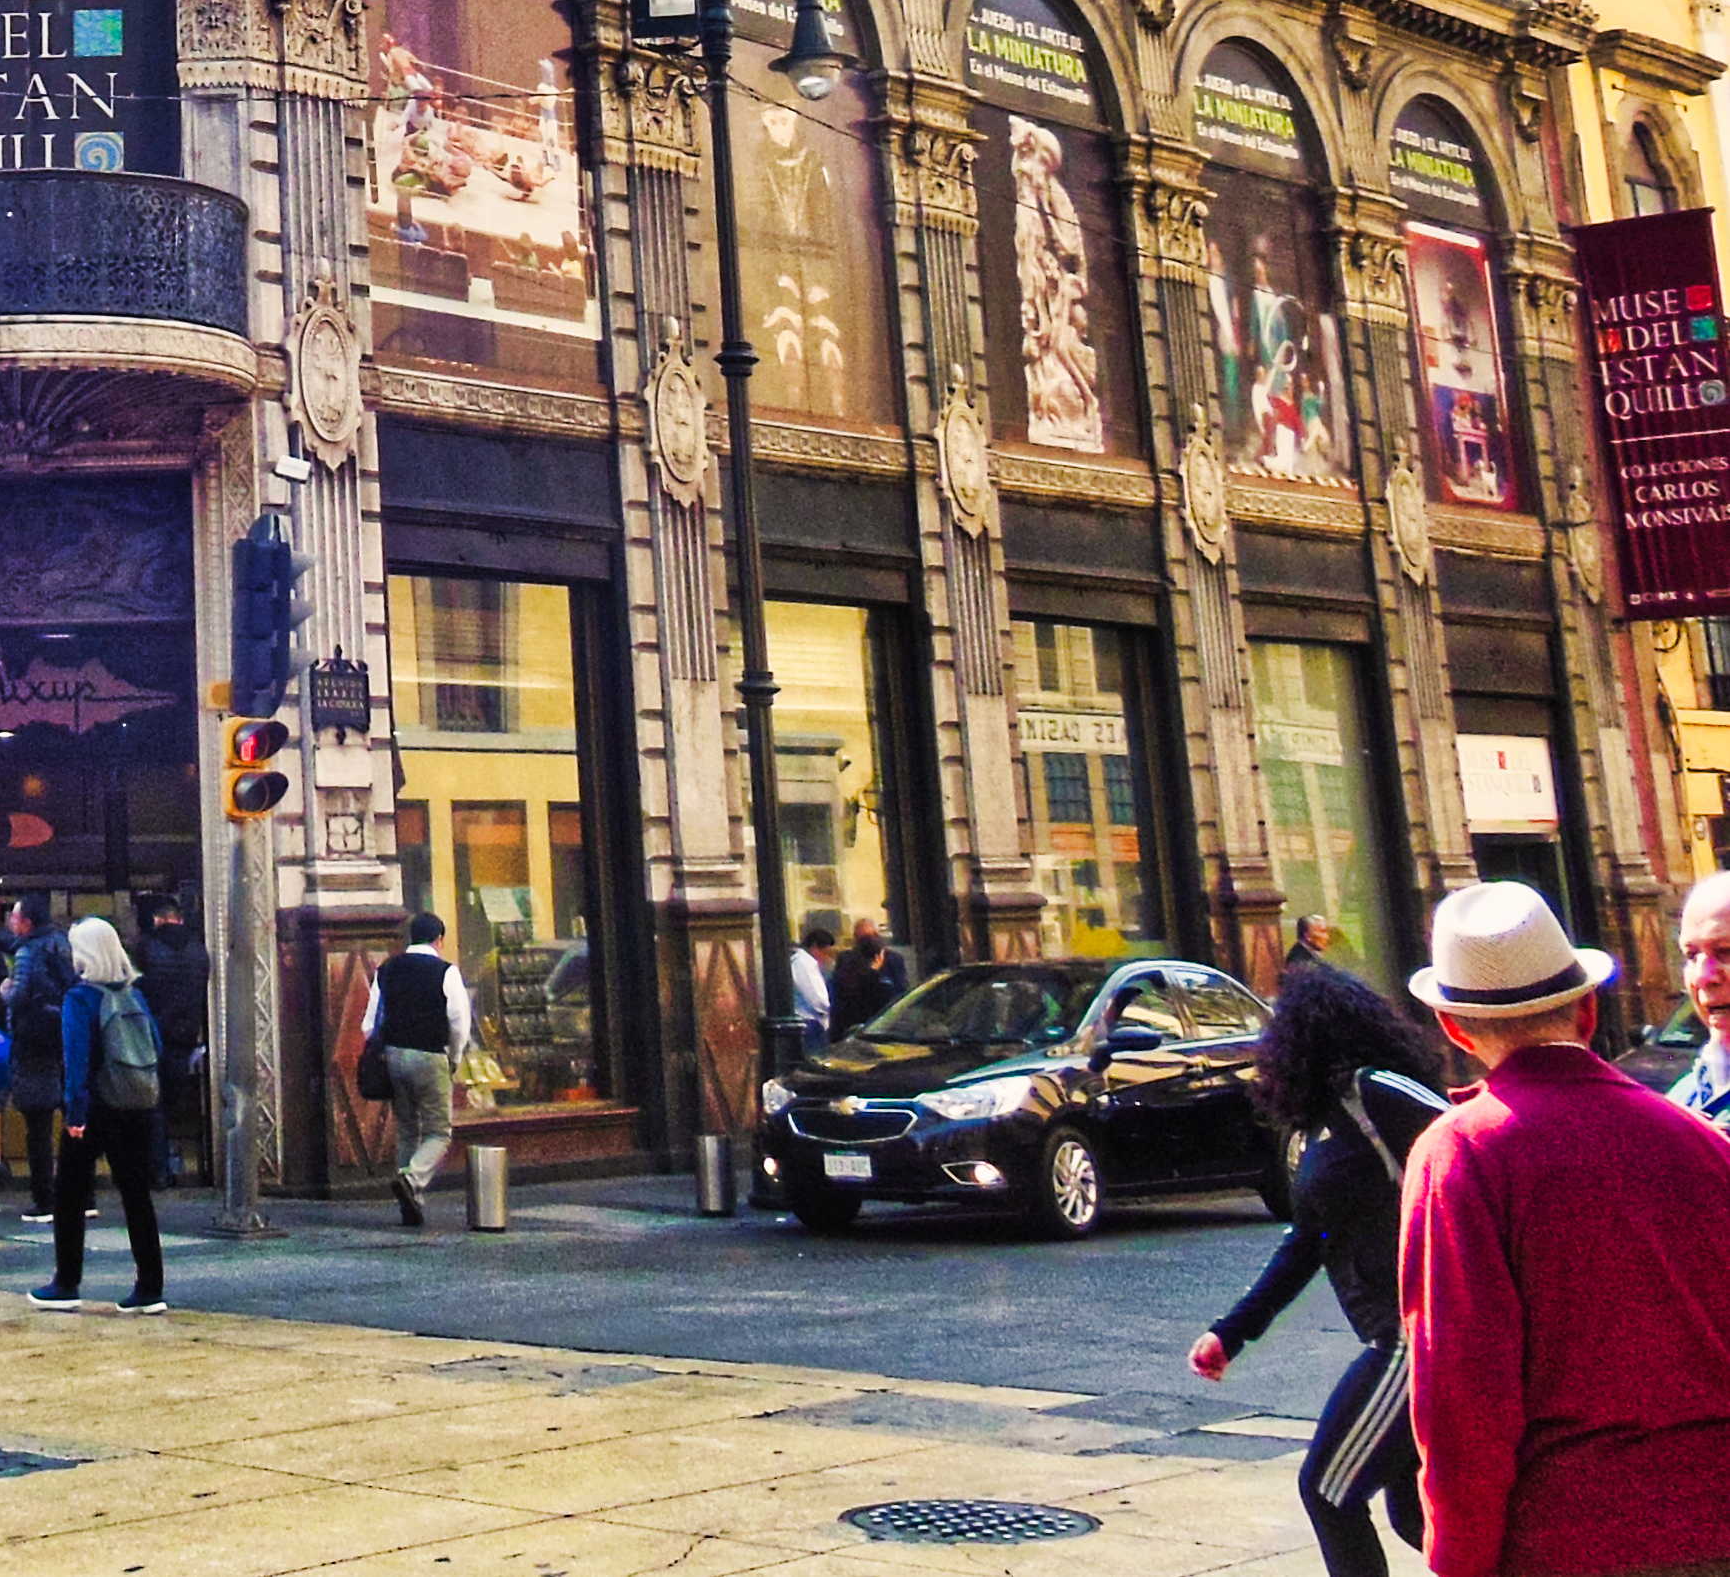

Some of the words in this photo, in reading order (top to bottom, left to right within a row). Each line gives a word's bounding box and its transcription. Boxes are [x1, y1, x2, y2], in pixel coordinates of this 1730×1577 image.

[966, 26, 991, 56] LA
[994, 34, 1088, 84] MINIATURA
[1192, 90, 1214, 119] LA
[1215, 97, 1296, 140] MINIATURA
[1591, 288, 1682, 325] MUSE
[1625, 319, 1690, 352] DEL
[1634, 479, 1721, 504] CARLOS
